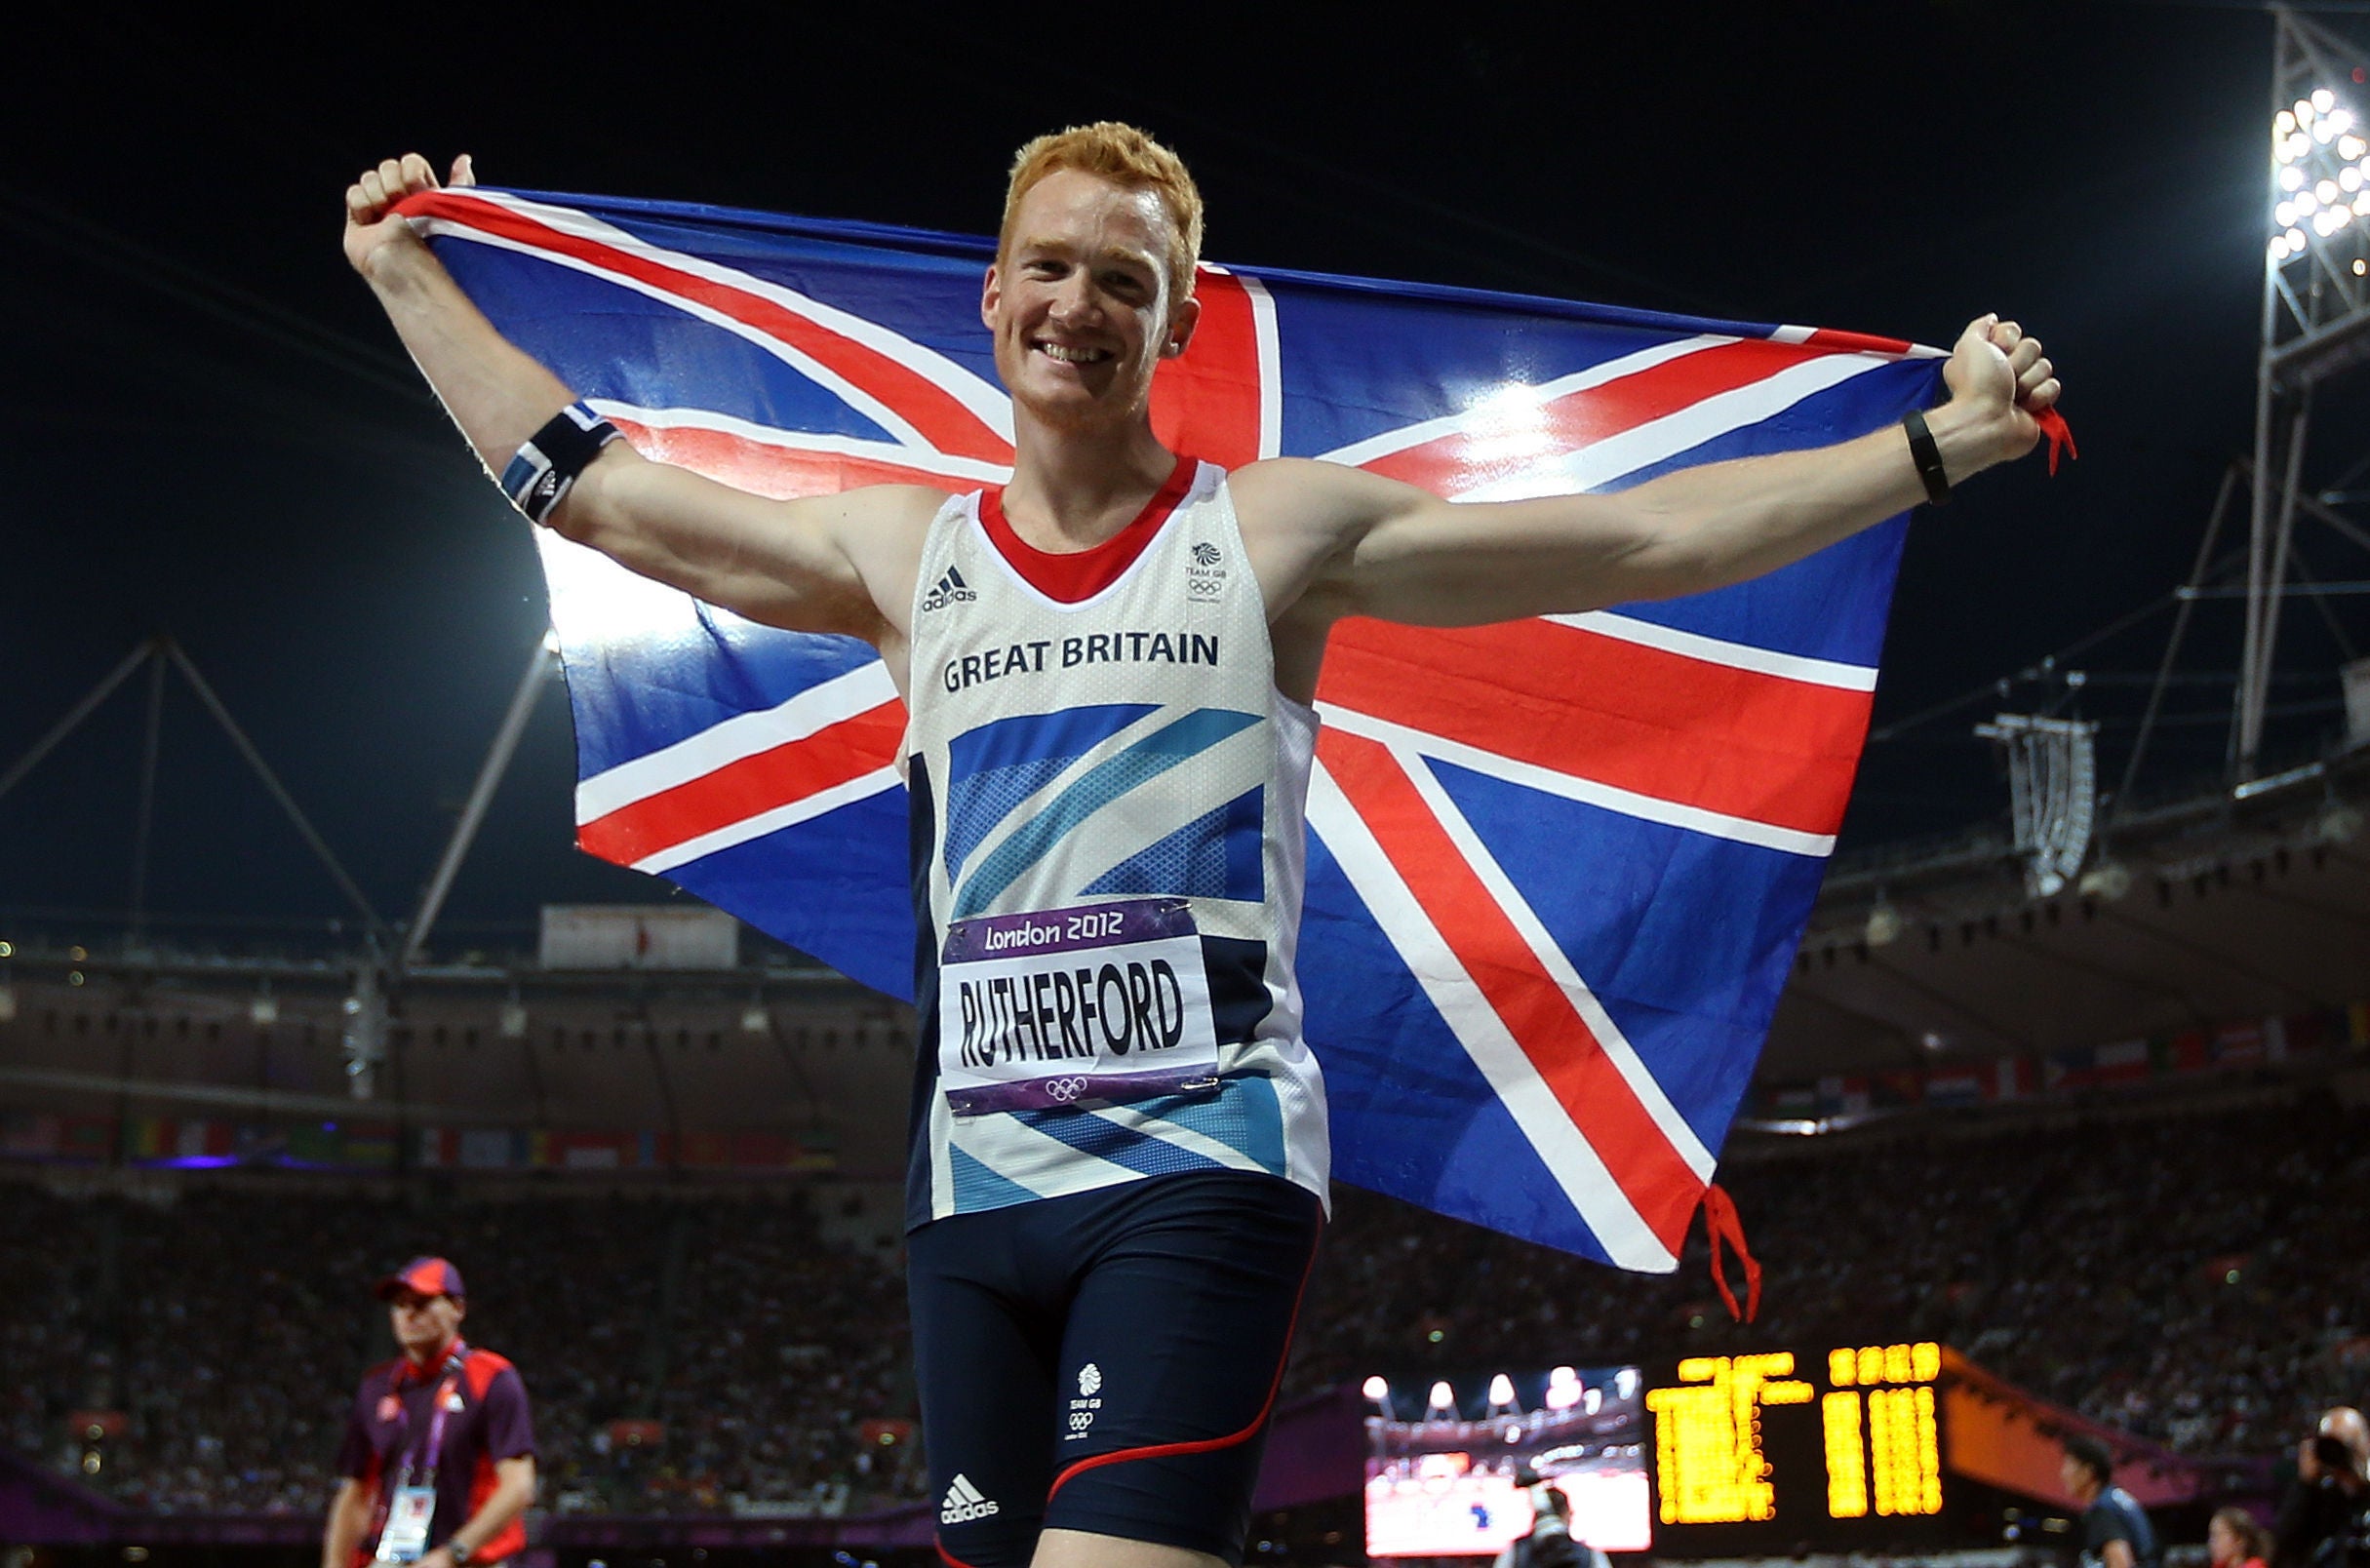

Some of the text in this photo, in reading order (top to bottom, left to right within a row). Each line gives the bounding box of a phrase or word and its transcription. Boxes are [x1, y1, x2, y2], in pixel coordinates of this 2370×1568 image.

[923, 589, 977, 612] adidas
[944, 632, 1218, 693] GREAT BRITAIN
[984, 912, 1124, 951] London 2012
[959, 959, 1184, 1069] RUTHERFORD
[940, 1502, 1000, 1524] adidas
